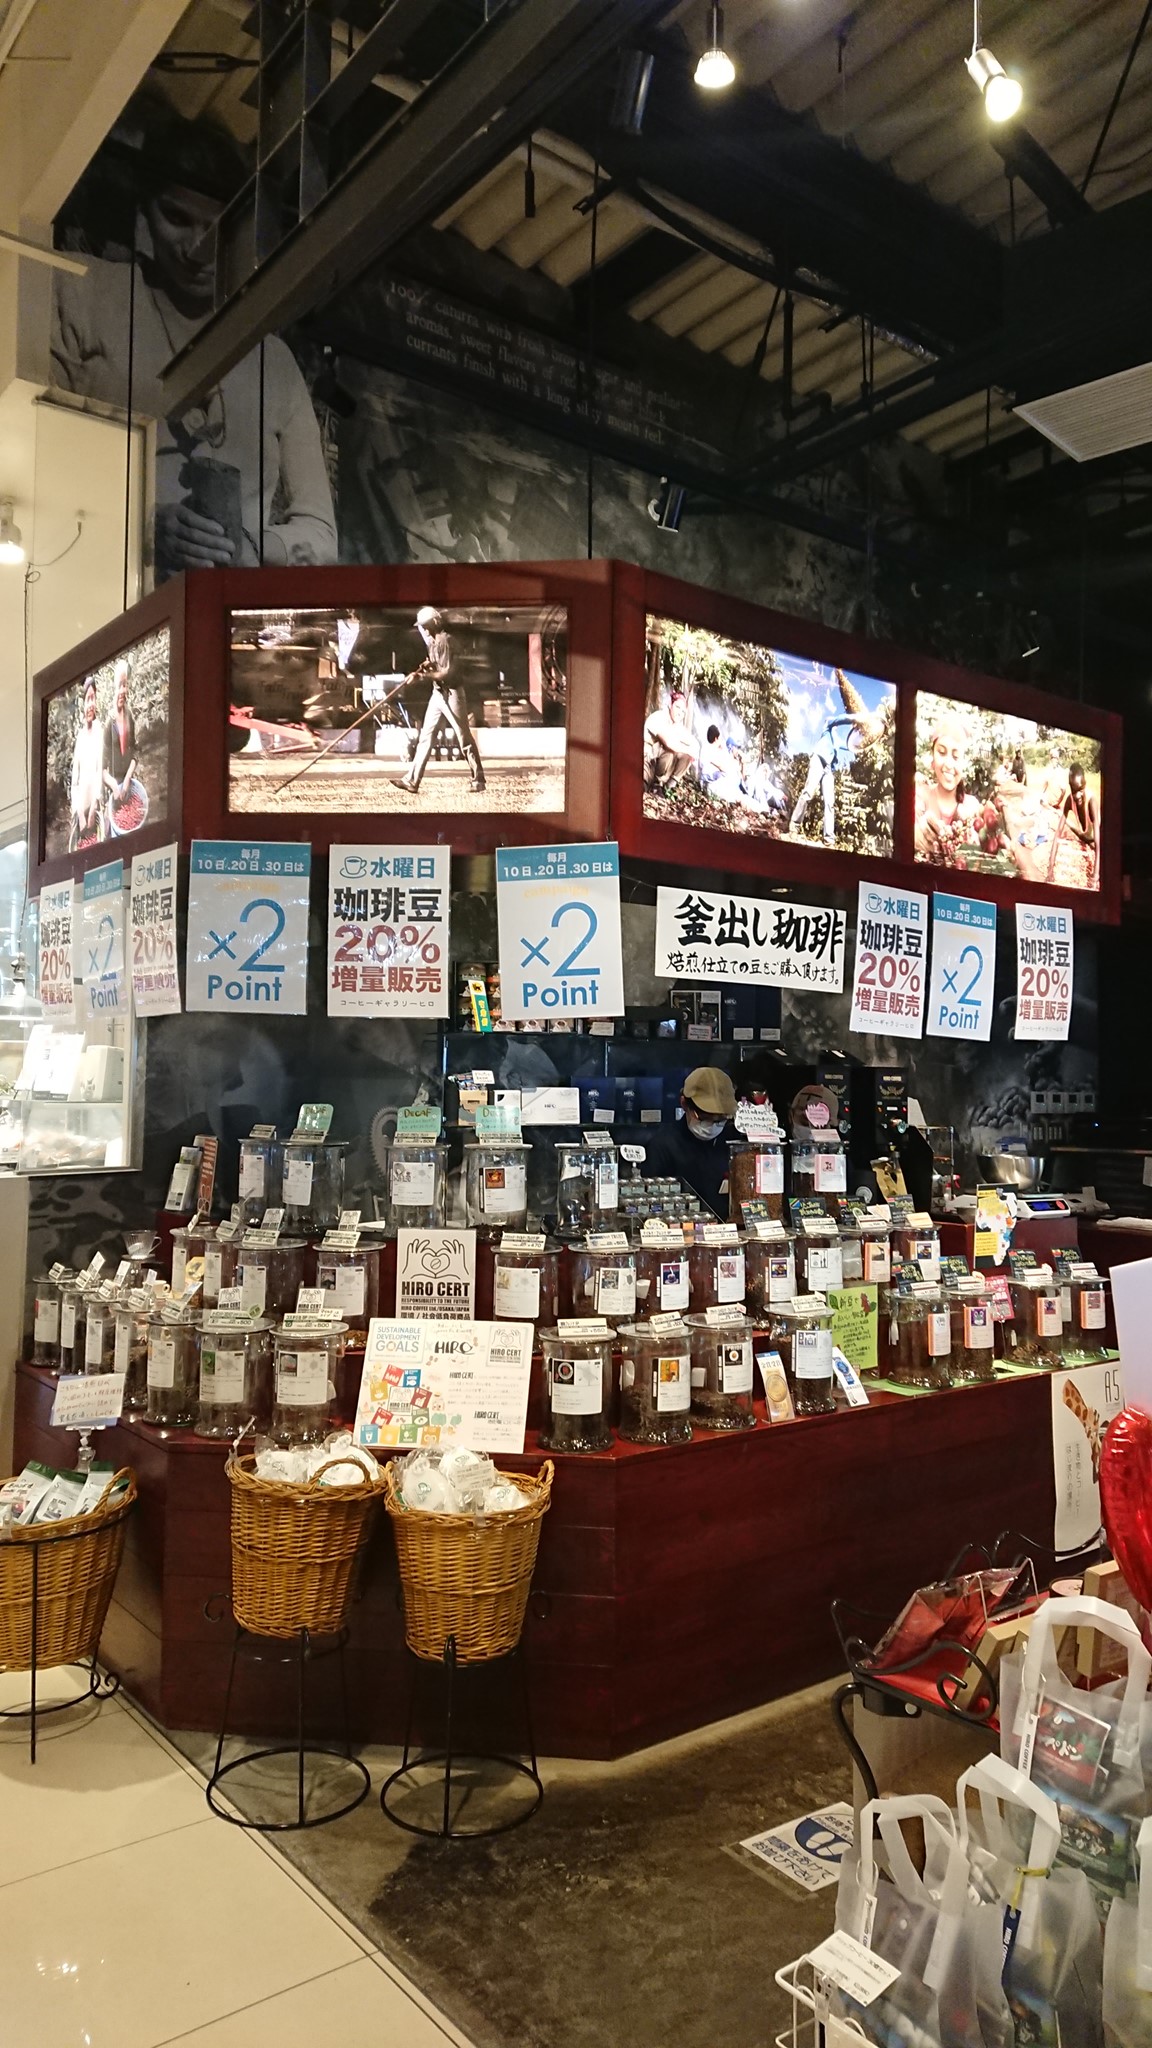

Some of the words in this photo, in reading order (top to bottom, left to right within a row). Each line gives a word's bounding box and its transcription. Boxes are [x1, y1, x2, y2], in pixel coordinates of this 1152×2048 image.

[435, 302, 479, 329] caturra
[487, 321, 512, 342] with
[406, 335, 457, 364] currants
[464, 353, 495, 379] finish
[502, 372, 528, 392] with
[533, 386, 541, 397] a
[547, 387, 571, 414] long
[608, 414, 640, 437] mouth
[241, 848, 260, 860] 毎月
[547, 852, 567, 863] 毎月
[146, 857, 172, 879] 水曜日
[370, 857, 435, 879] 水曜日
[132, 886, 174, 926] 珈琲豆
[333, 886, 443, 923] 珈琲豆
[883, 897, 921, 922] 水曜日
[673, 894, 844, 965] 釜出し珈琲
[1036, 914, 1067, 934] 水曜日
[133, 923, 173, 965] 20%
[334, 924, 441, 964] 20%
[859, 919, 923, 959] 珈琲豆
[1020, 937, 1070, 967] 珈琲豆
[41, 947, 71, 982] 20%
[858, 952, 921, 994] 20%
[208, 975, 282, 1001] Point
[332, 967, 442, 993] 増量販売
[1020, 967, 1069, 999] 20%
[91, 984, 118, 1009] Point
[340, 999, 435, 1008] コーヒーギャラリーヒロ
[522, 980, 599, 1008] Point
[855, 990, 920, 1018] 増量販売
[939, 1005, 980, 1030] Point
[1019, 998, 1068, 1021] 増量販売
[402, 1282, 434, 1296] HIRO
[437, 1282, 470, 1297] CERT
[377, 1326, 422, 1334] SUSTAINABLE
[375, 1341, 419, 1353] GOALS
[490, 1348, 504, 1356] HIRO
[507, 1349, 521, 1357] CERT
